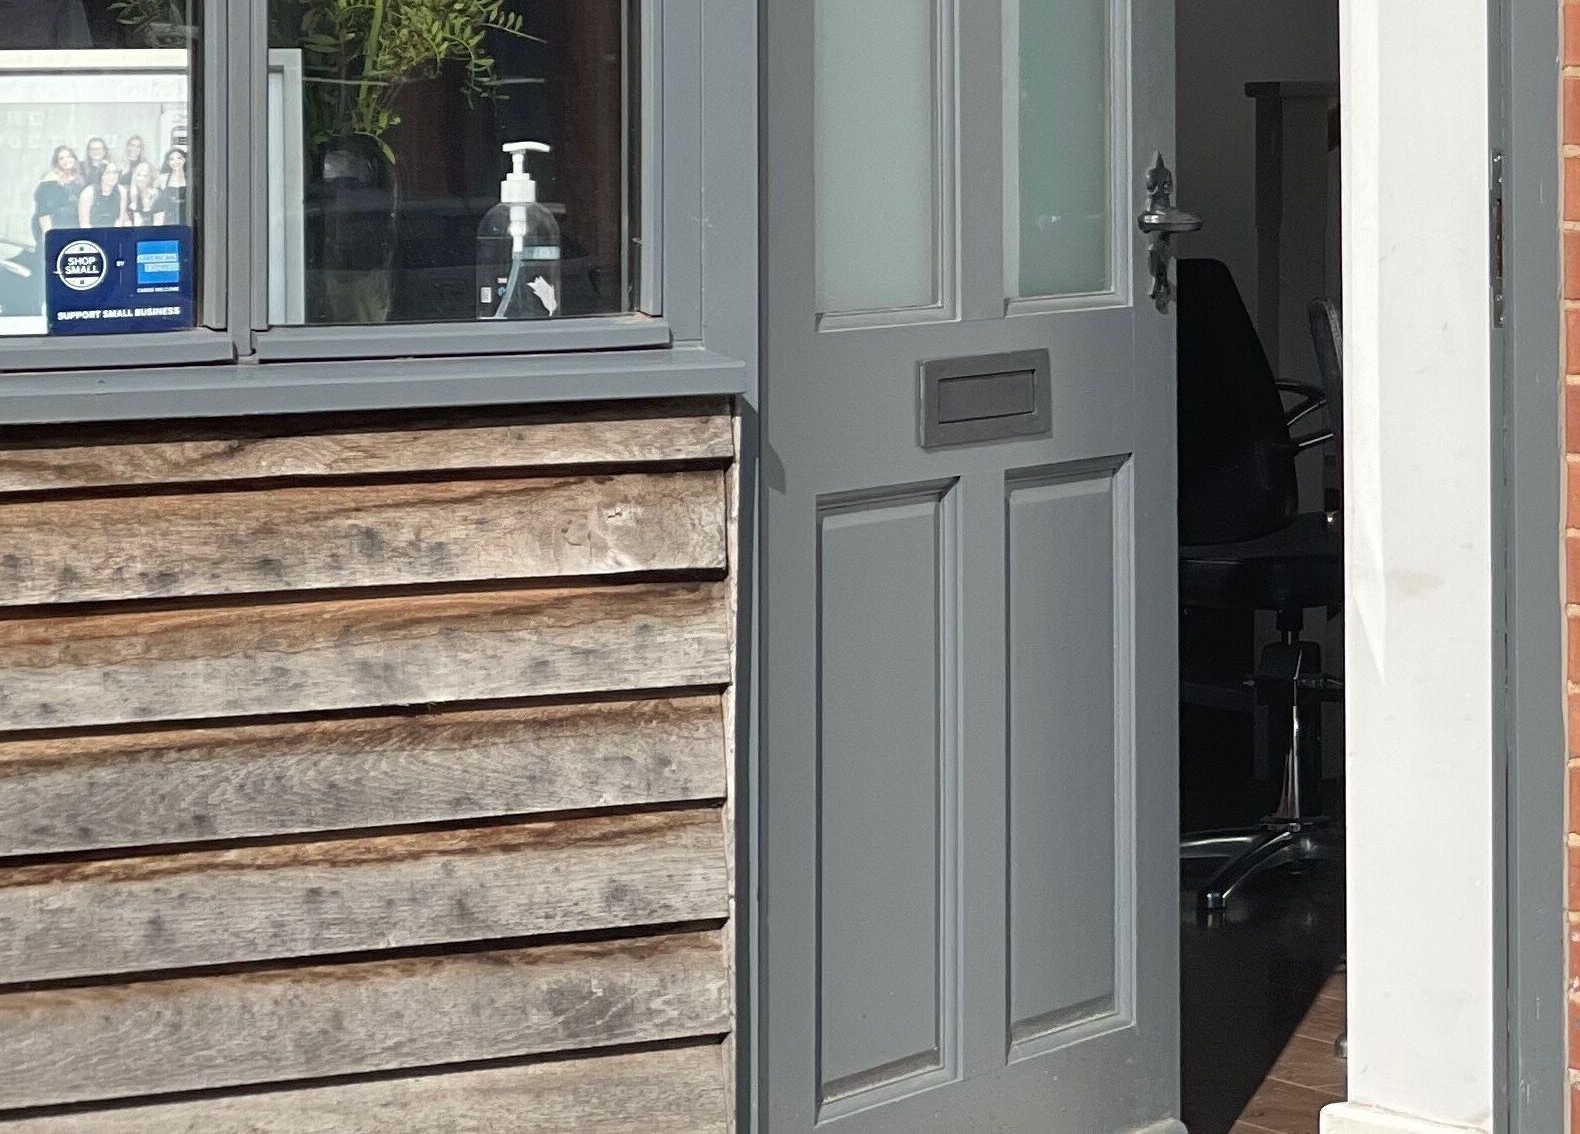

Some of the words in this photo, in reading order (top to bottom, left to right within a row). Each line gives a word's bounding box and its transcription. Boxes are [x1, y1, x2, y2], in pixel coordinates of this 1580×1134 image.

[67, 257, 96, 266] SHOP
[65, 265, 100, 274] SMALL
[57, 309, 101, 321] SUPPORT
[102, 309, 133, 319] SMALL
[134, 306, 181, 317] BUSINESS
